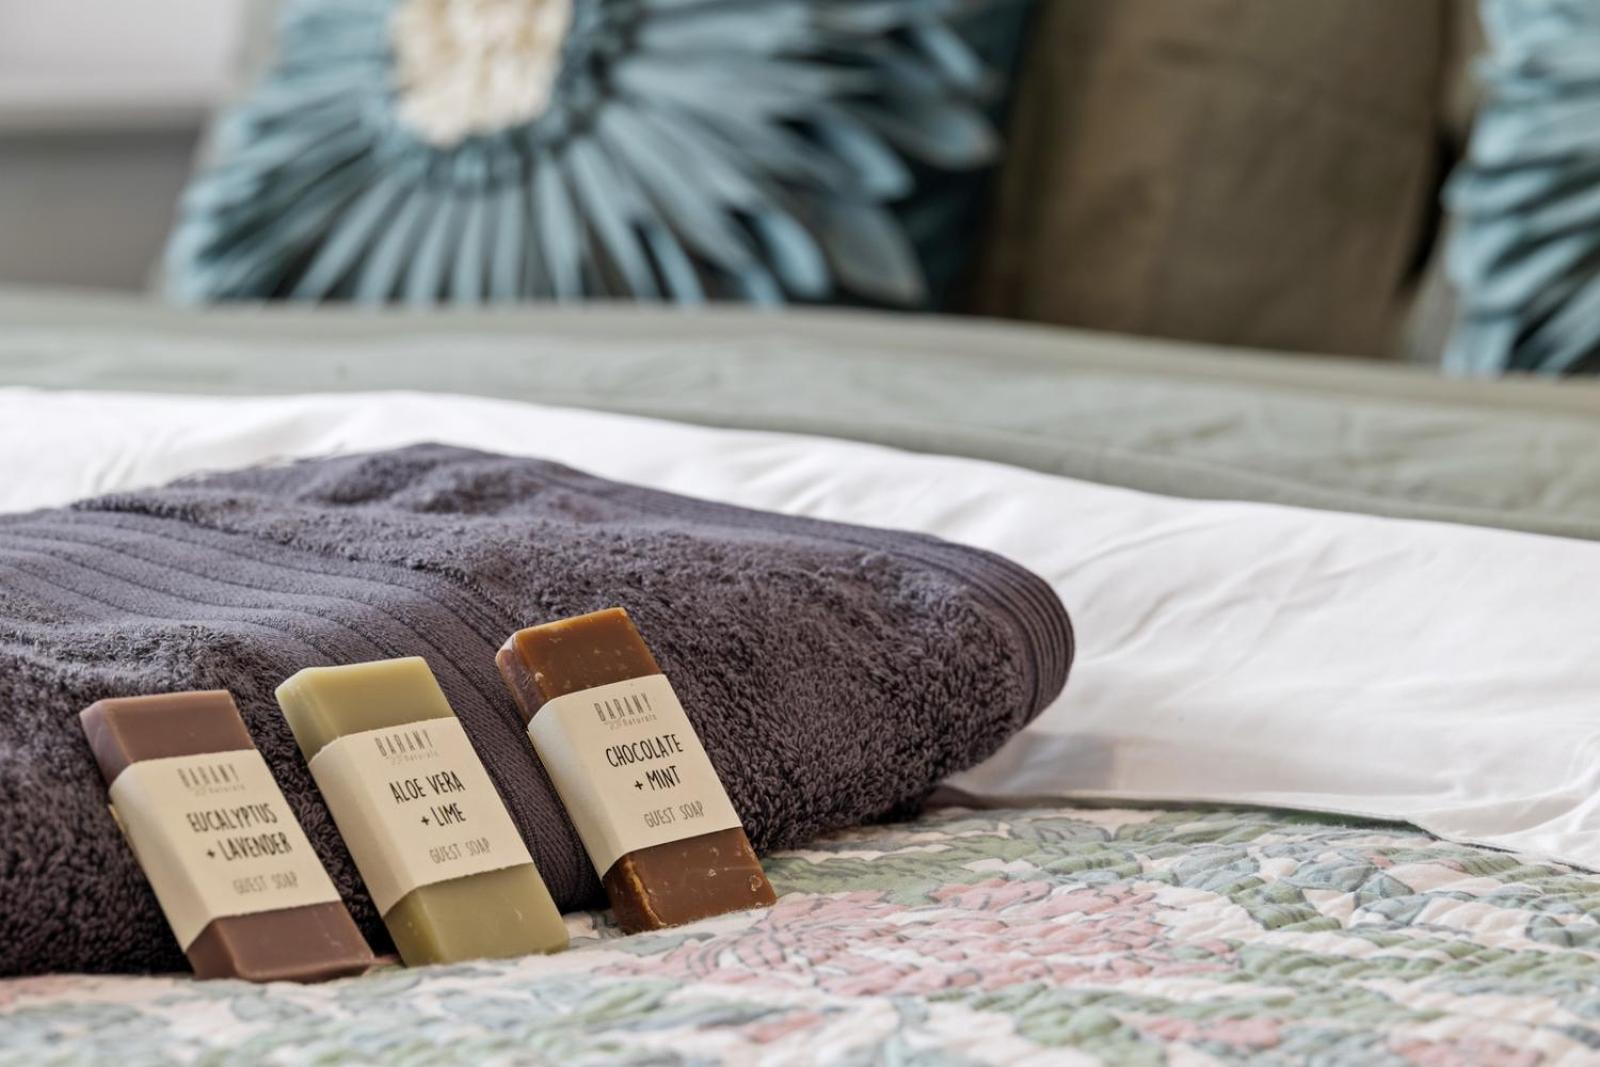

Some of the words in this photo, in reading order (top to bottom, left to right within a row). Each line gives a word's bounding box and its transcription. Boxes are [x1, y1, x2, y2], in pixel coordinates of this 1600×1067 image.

[605, 734, 684, 768] CHOCOLATE
[389, 778, 427, 804] ALOE
[425, 770, 466, 795] VERA
[634, 780, 644, 791] +
[645, 765, 682, 791] MINT
[186, 803, 278, 833] EUCALYPTUS
[421, 816, 430, 826] +
[430, 803, 467, 827] LIME
[643, 807, 676, 828] GUEST
[680, 800, 705, 820] SOAP
[217, 832, 293, 861] LAVENDER
[429, 843, 462, 864] GUEST
[465, 837, 491, 857] SOAP
[233, 875, 268, 894] GUEST
[271, 871, 299, 890] SOAP
